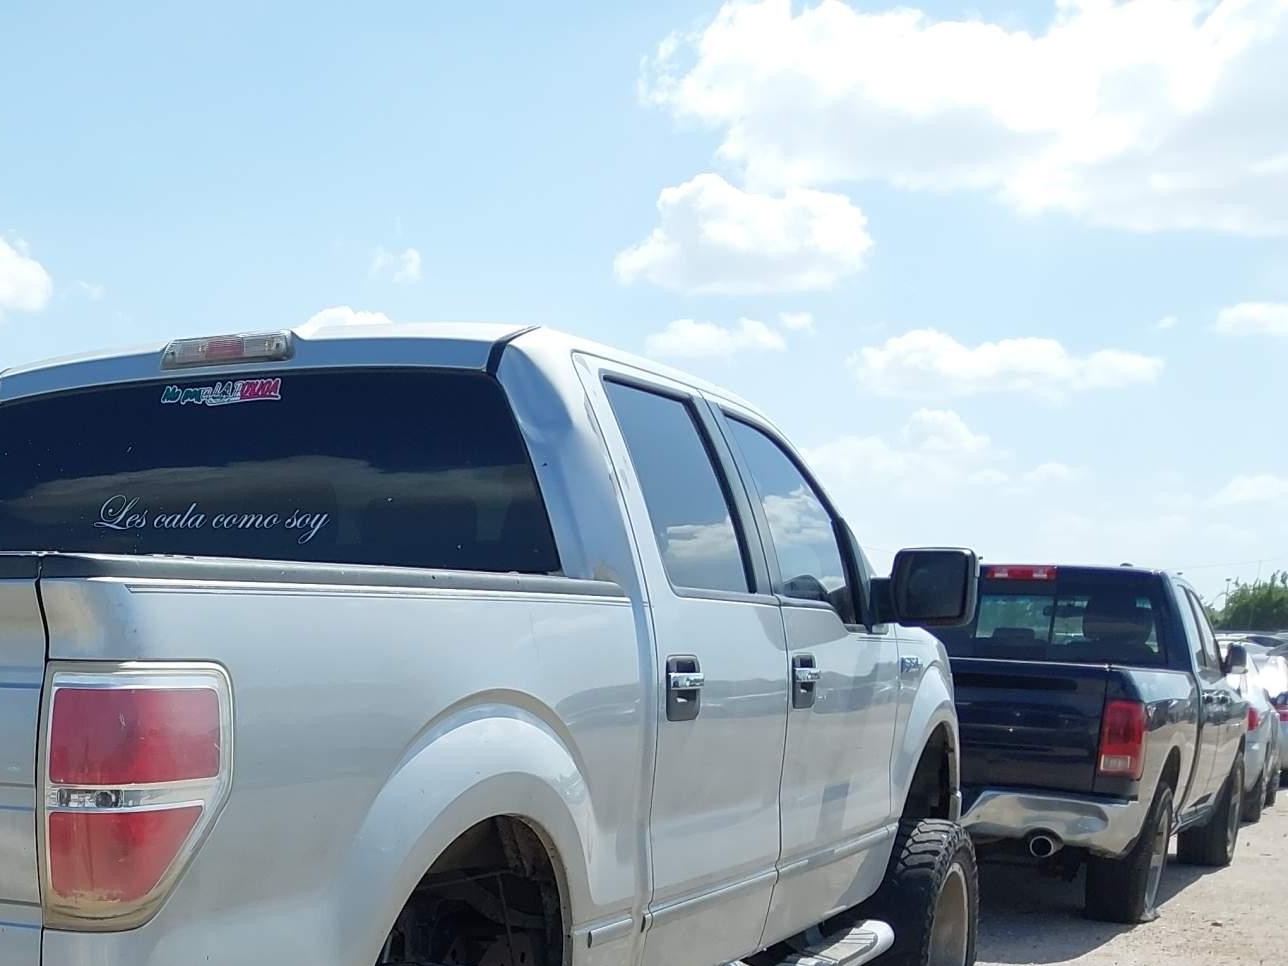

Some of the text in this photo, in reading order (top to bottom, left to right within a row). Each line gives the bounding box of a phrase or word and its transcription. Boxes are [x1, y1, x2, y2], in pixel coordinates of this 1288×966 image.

[93, 494, 330, 544] Les cala como soy
